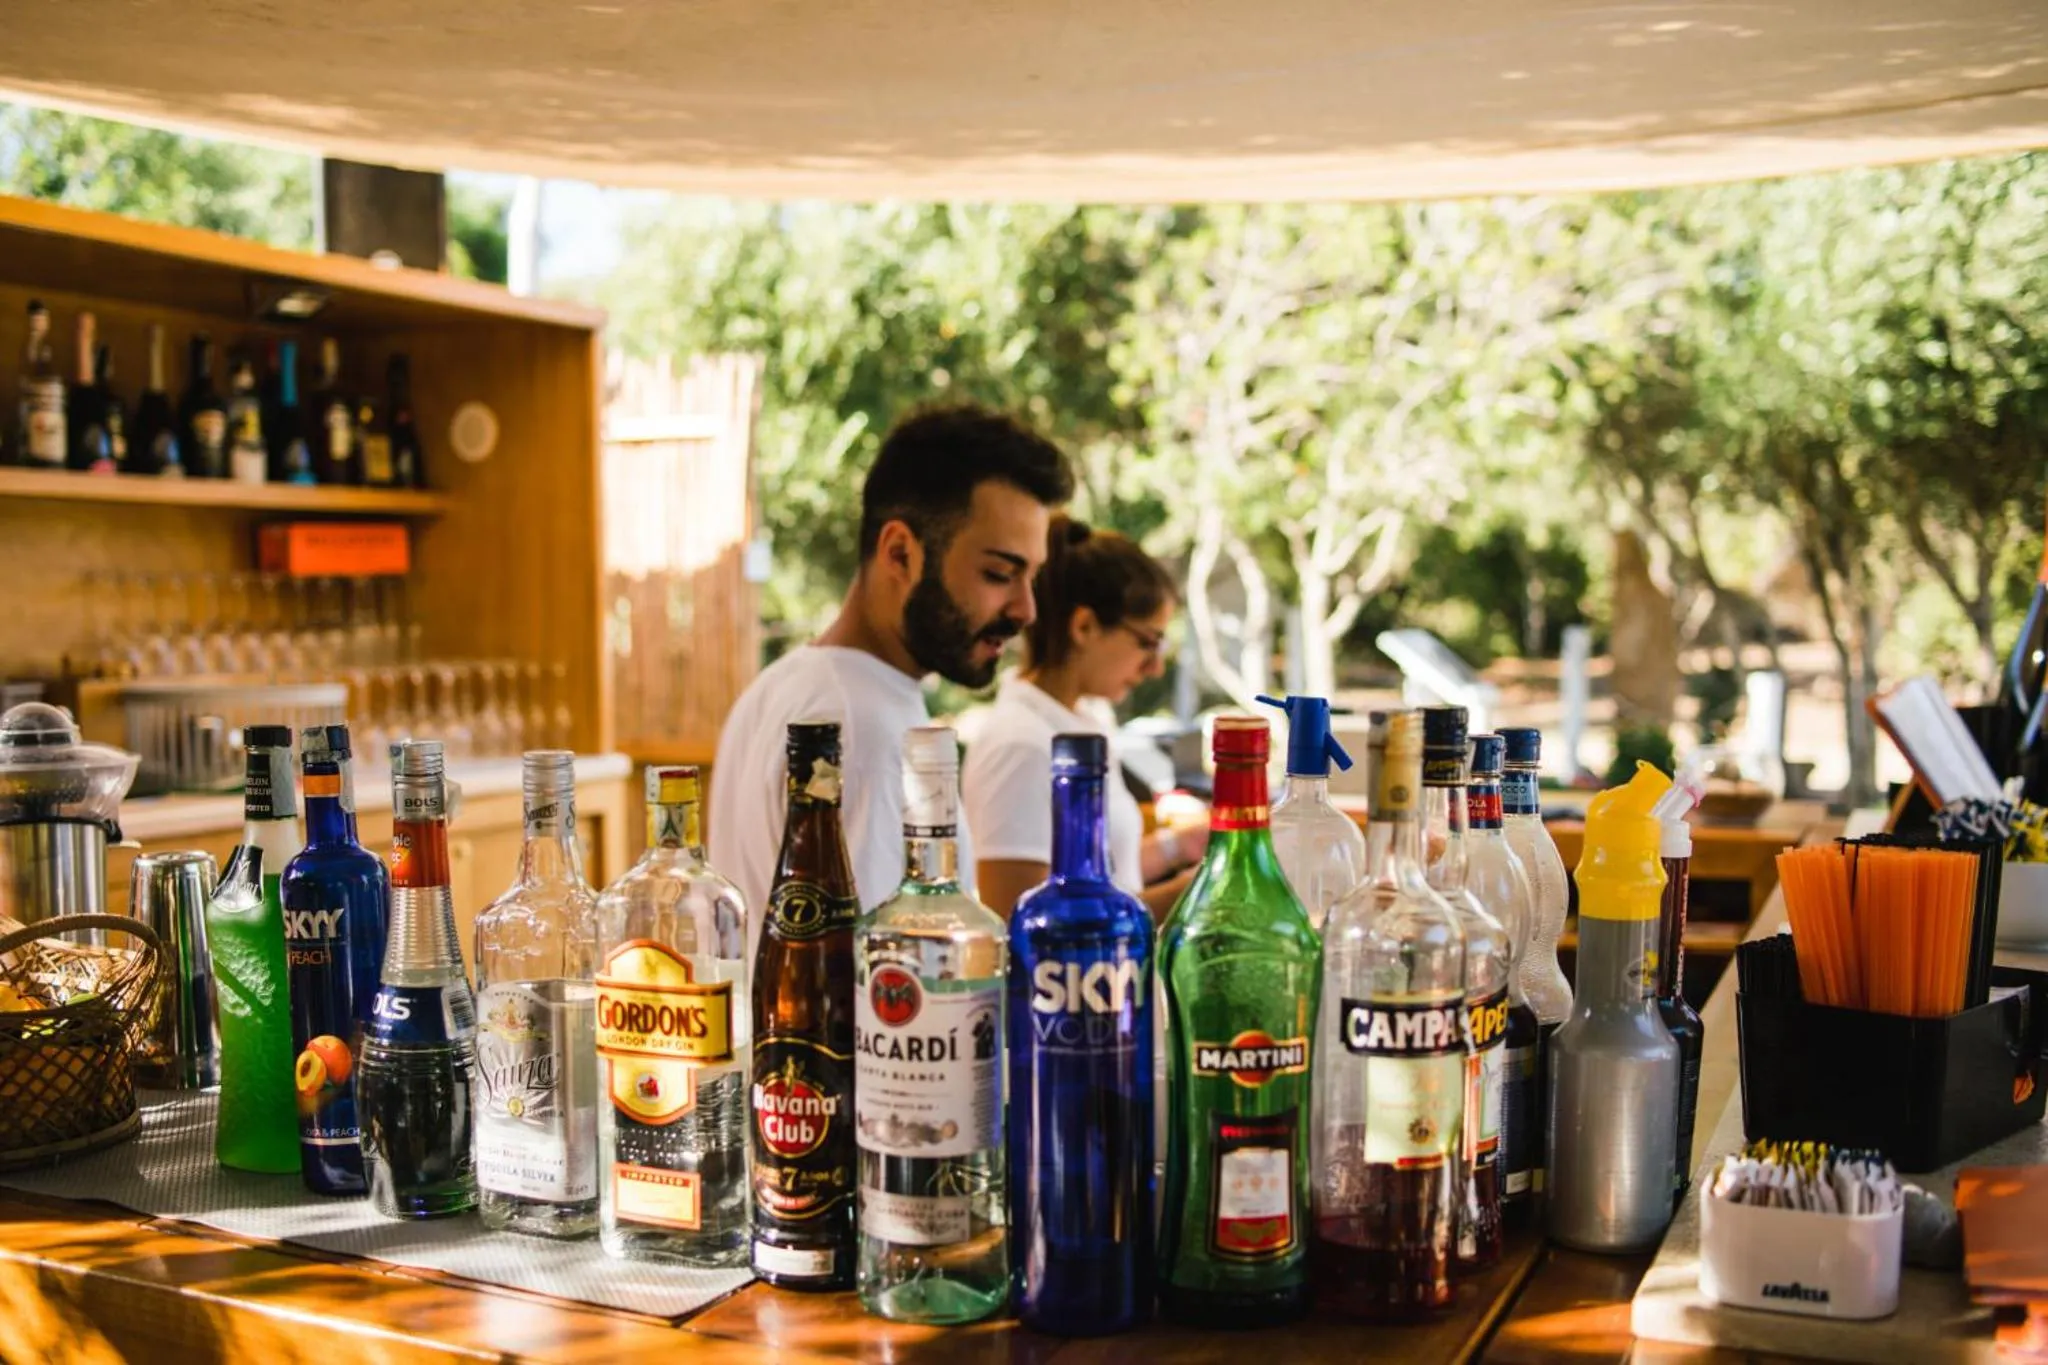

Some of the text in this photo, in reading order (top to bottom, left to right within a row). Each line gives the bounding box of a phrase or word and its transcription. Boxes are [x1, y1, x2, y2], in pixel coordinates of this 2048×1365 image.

[792, 899, 807, 922] 7
[598, 995, 708, 1038] GORDON'S
[1200, 1045, 1302, 1068] MARTINI
[752, 1083, 836, 1116] Havana
[764, 1115, 816, 1144] Club
